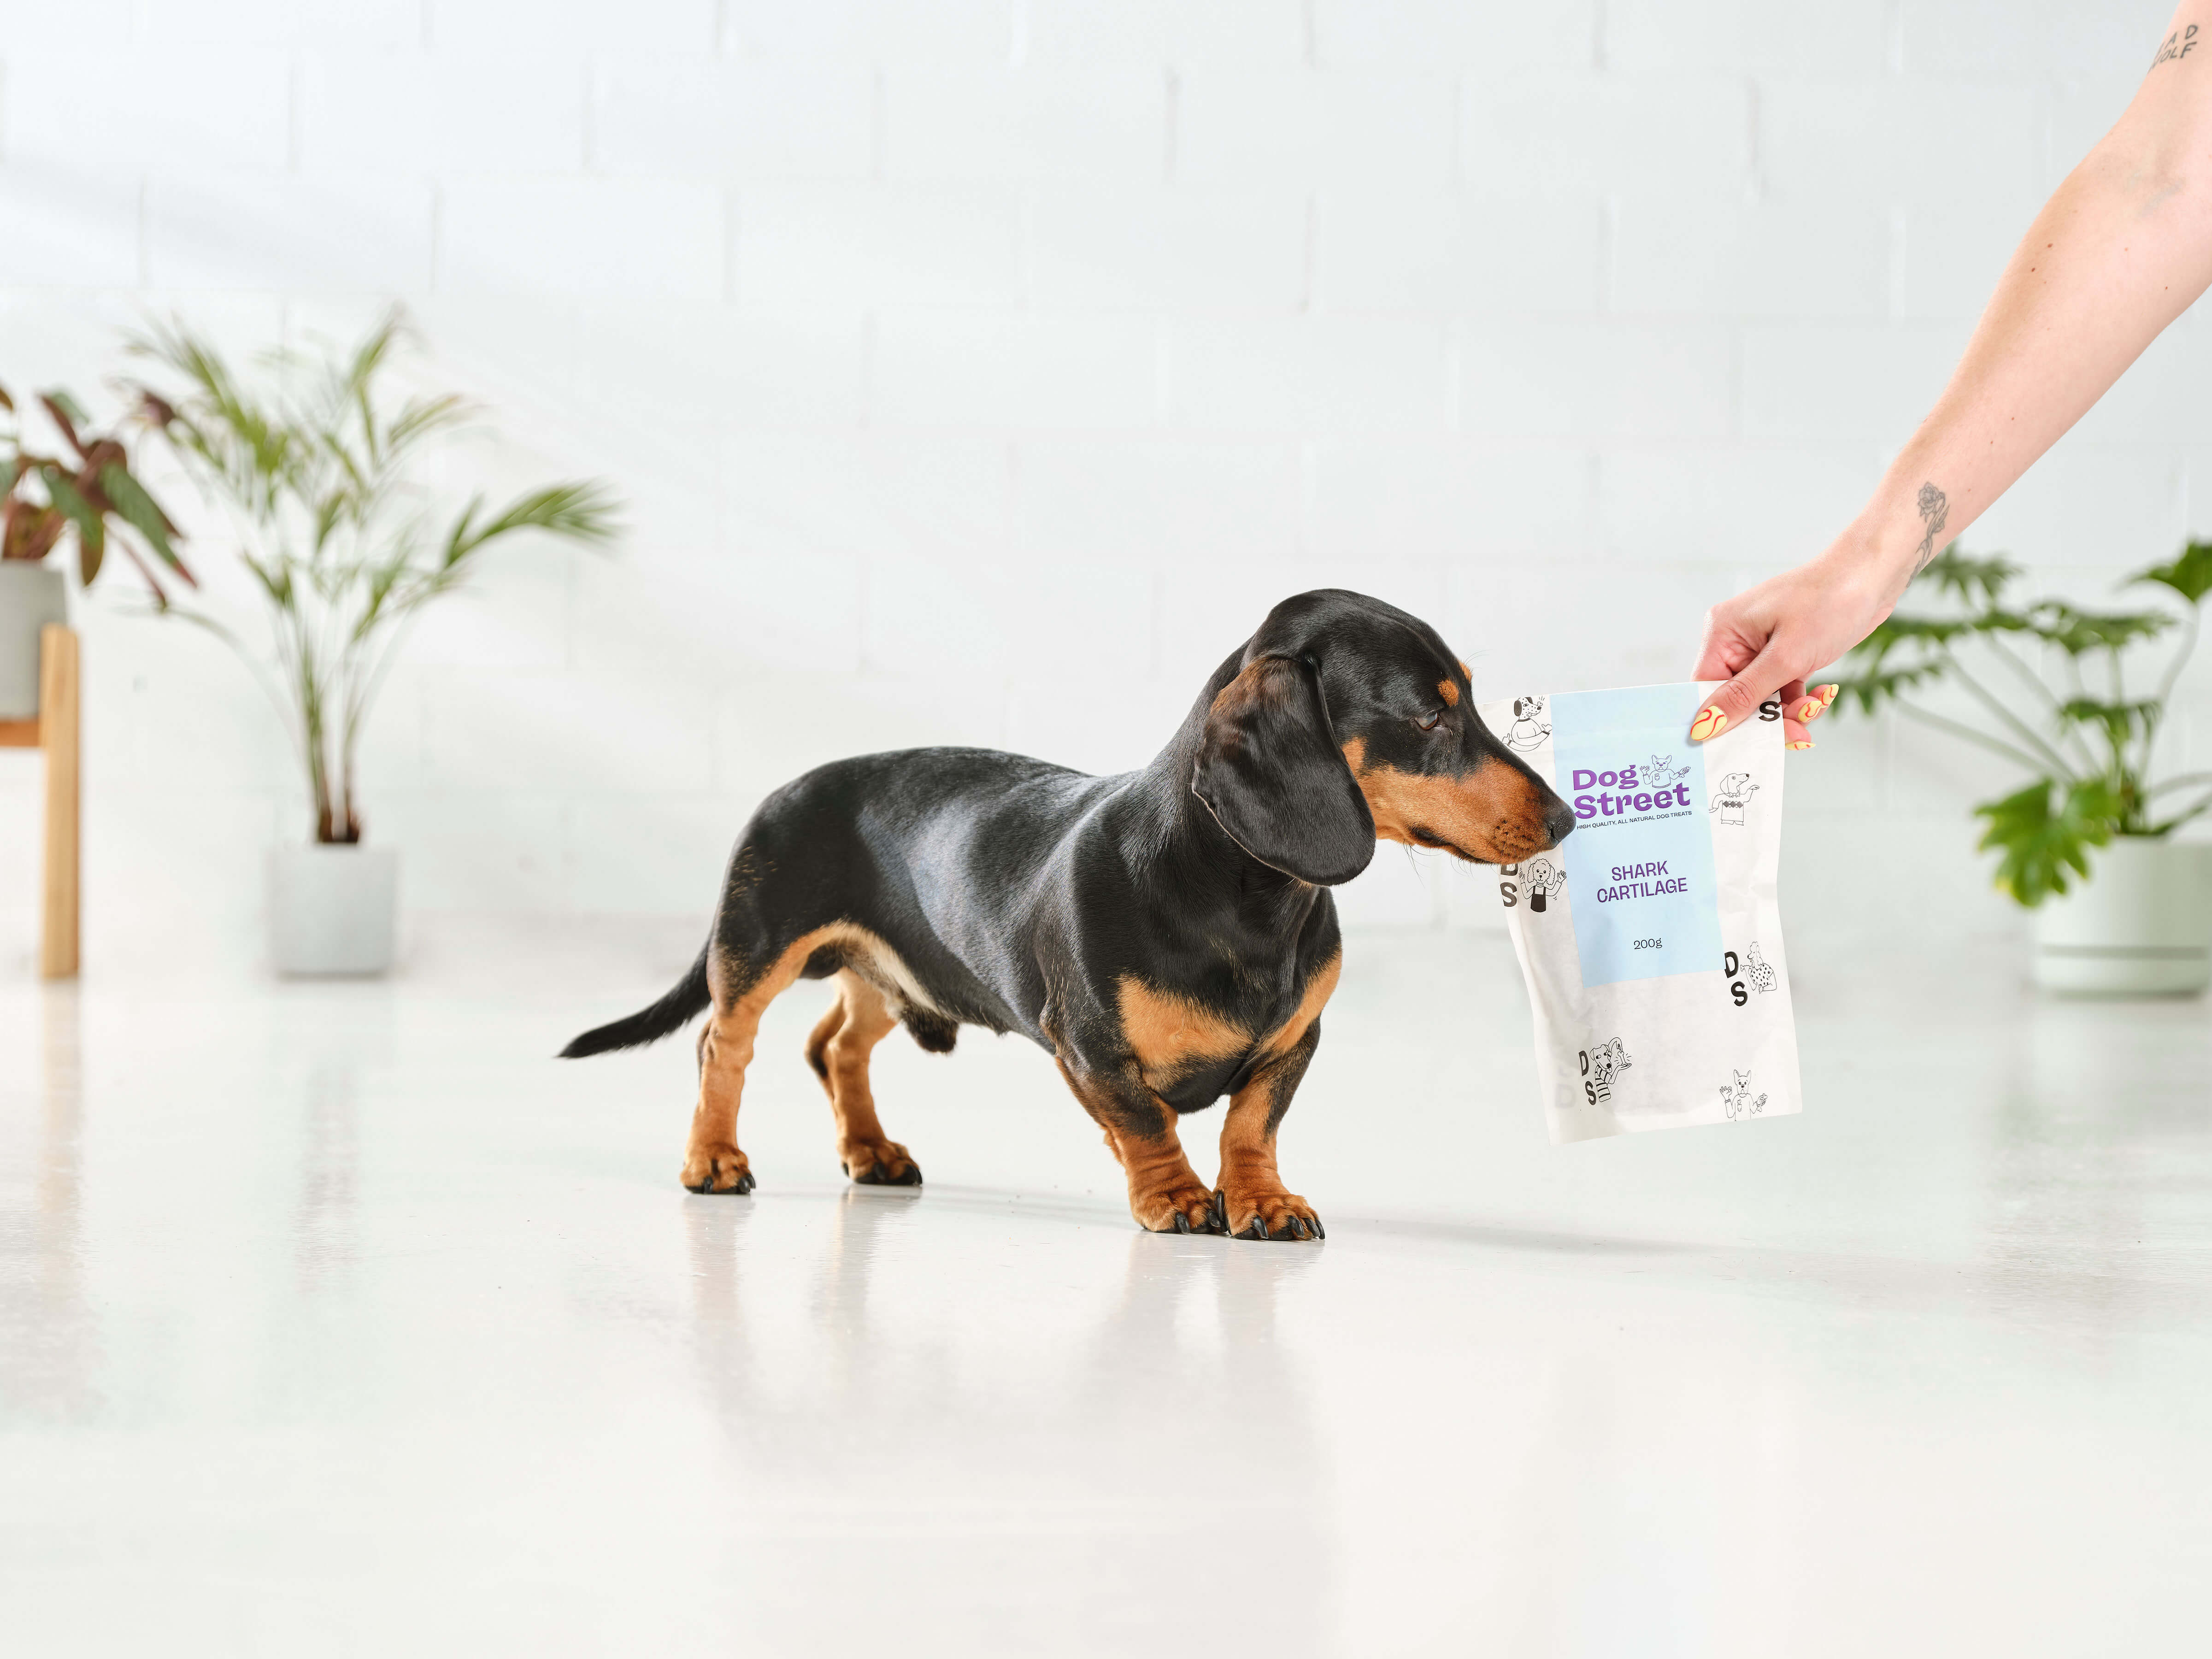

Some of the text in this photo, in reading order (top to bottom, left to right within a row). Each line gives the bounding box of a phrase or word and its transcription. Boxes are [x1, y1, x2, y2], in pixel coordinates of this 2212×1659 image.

[1759, 701, 1781, 722] S
[1573, 765, 1639, 790] Dog
[1574, 782, 1690, 819] Street
[1612, 860, 1669, 881] SHARK
[1500, 882, 1518, 907] S
[1597, 877, 1688, 903] CARTILAGE
[1634, 938, 1662, 949] 200g
[1724, 951, 1739, 978] D
[1731, 981, 1748, 1006] S
[1578, 1050, 1589, 1077] D
[1585, 1080, 1597, 1106] S
